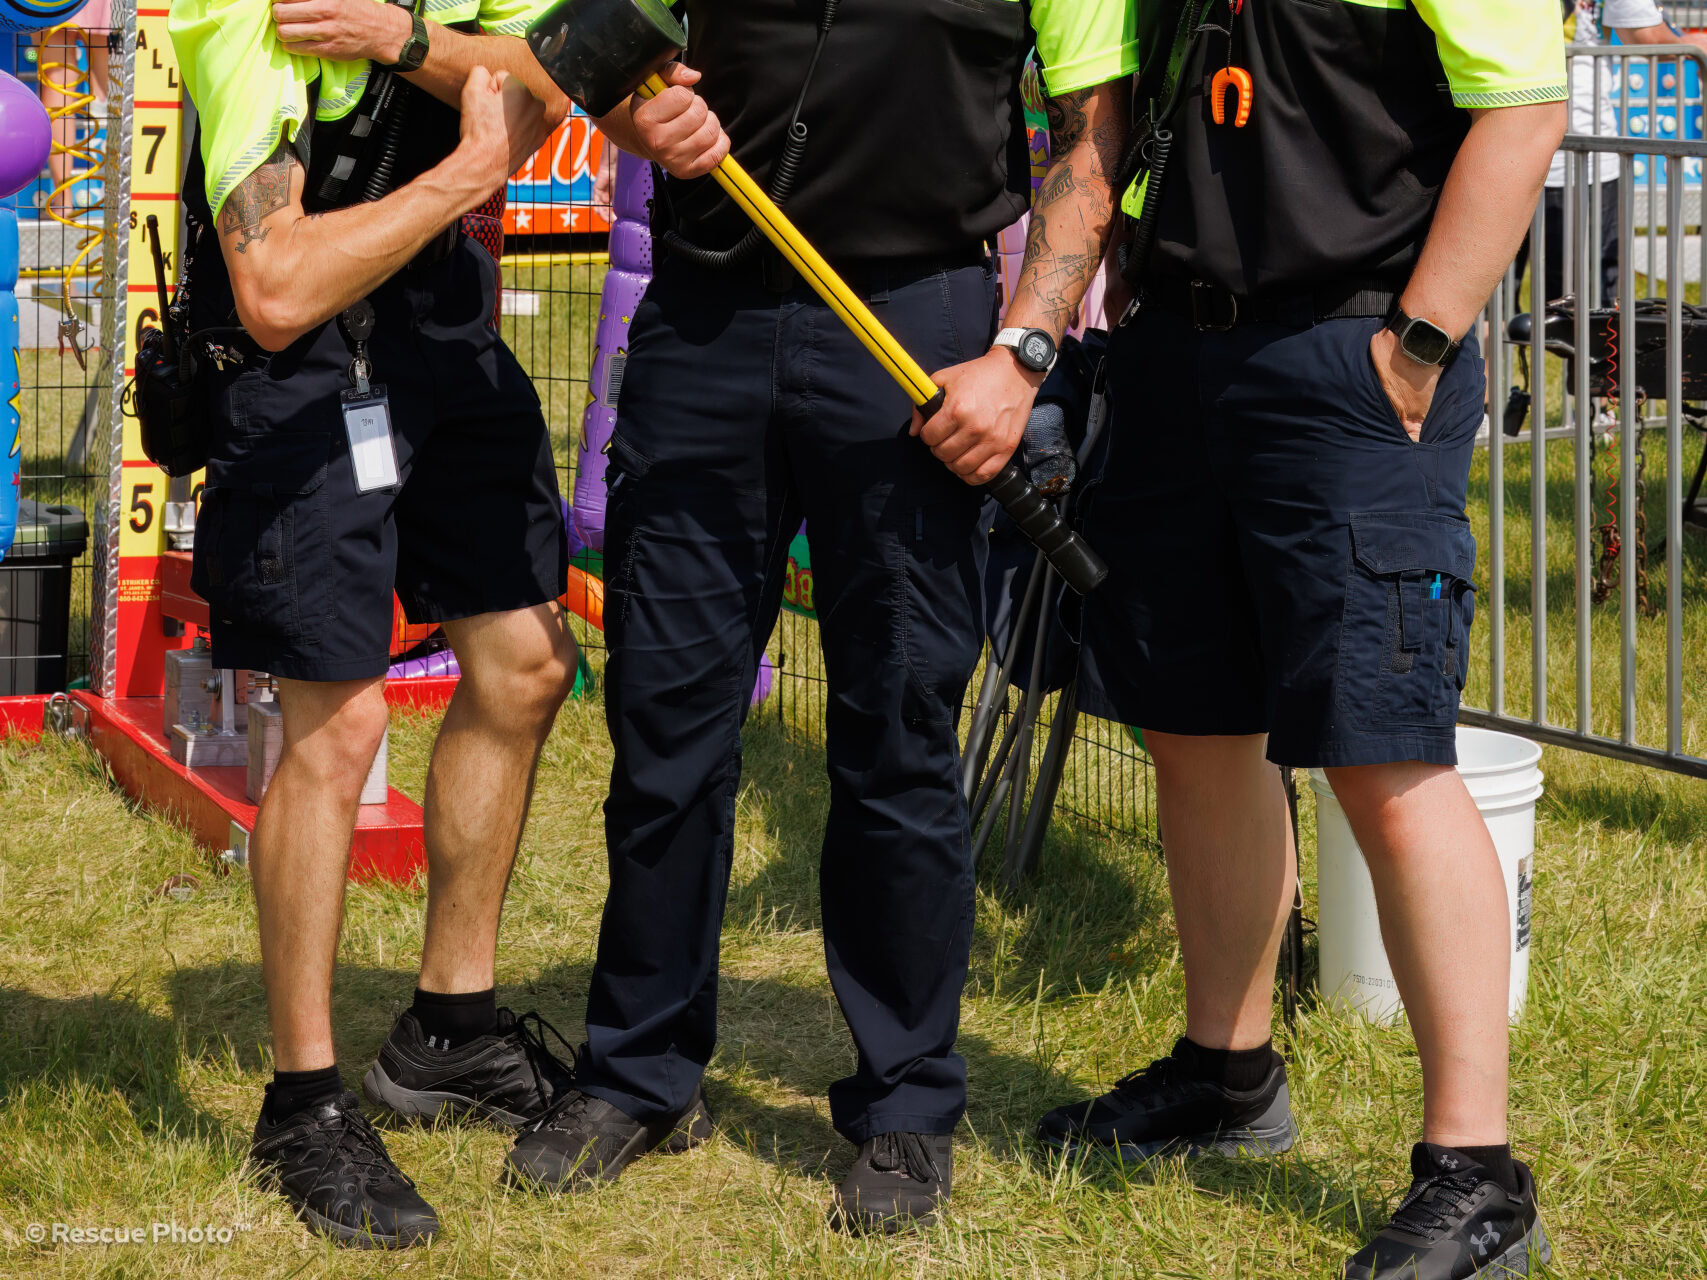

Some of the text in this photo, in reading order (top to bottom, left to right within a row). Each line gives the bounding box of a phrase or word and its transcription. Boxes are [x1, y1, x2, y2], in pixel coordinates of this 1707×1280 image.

[136, 29, 178, 88] ALL
[141, 125, 167, 175] 7
[129, 483, 153, 533] 5
